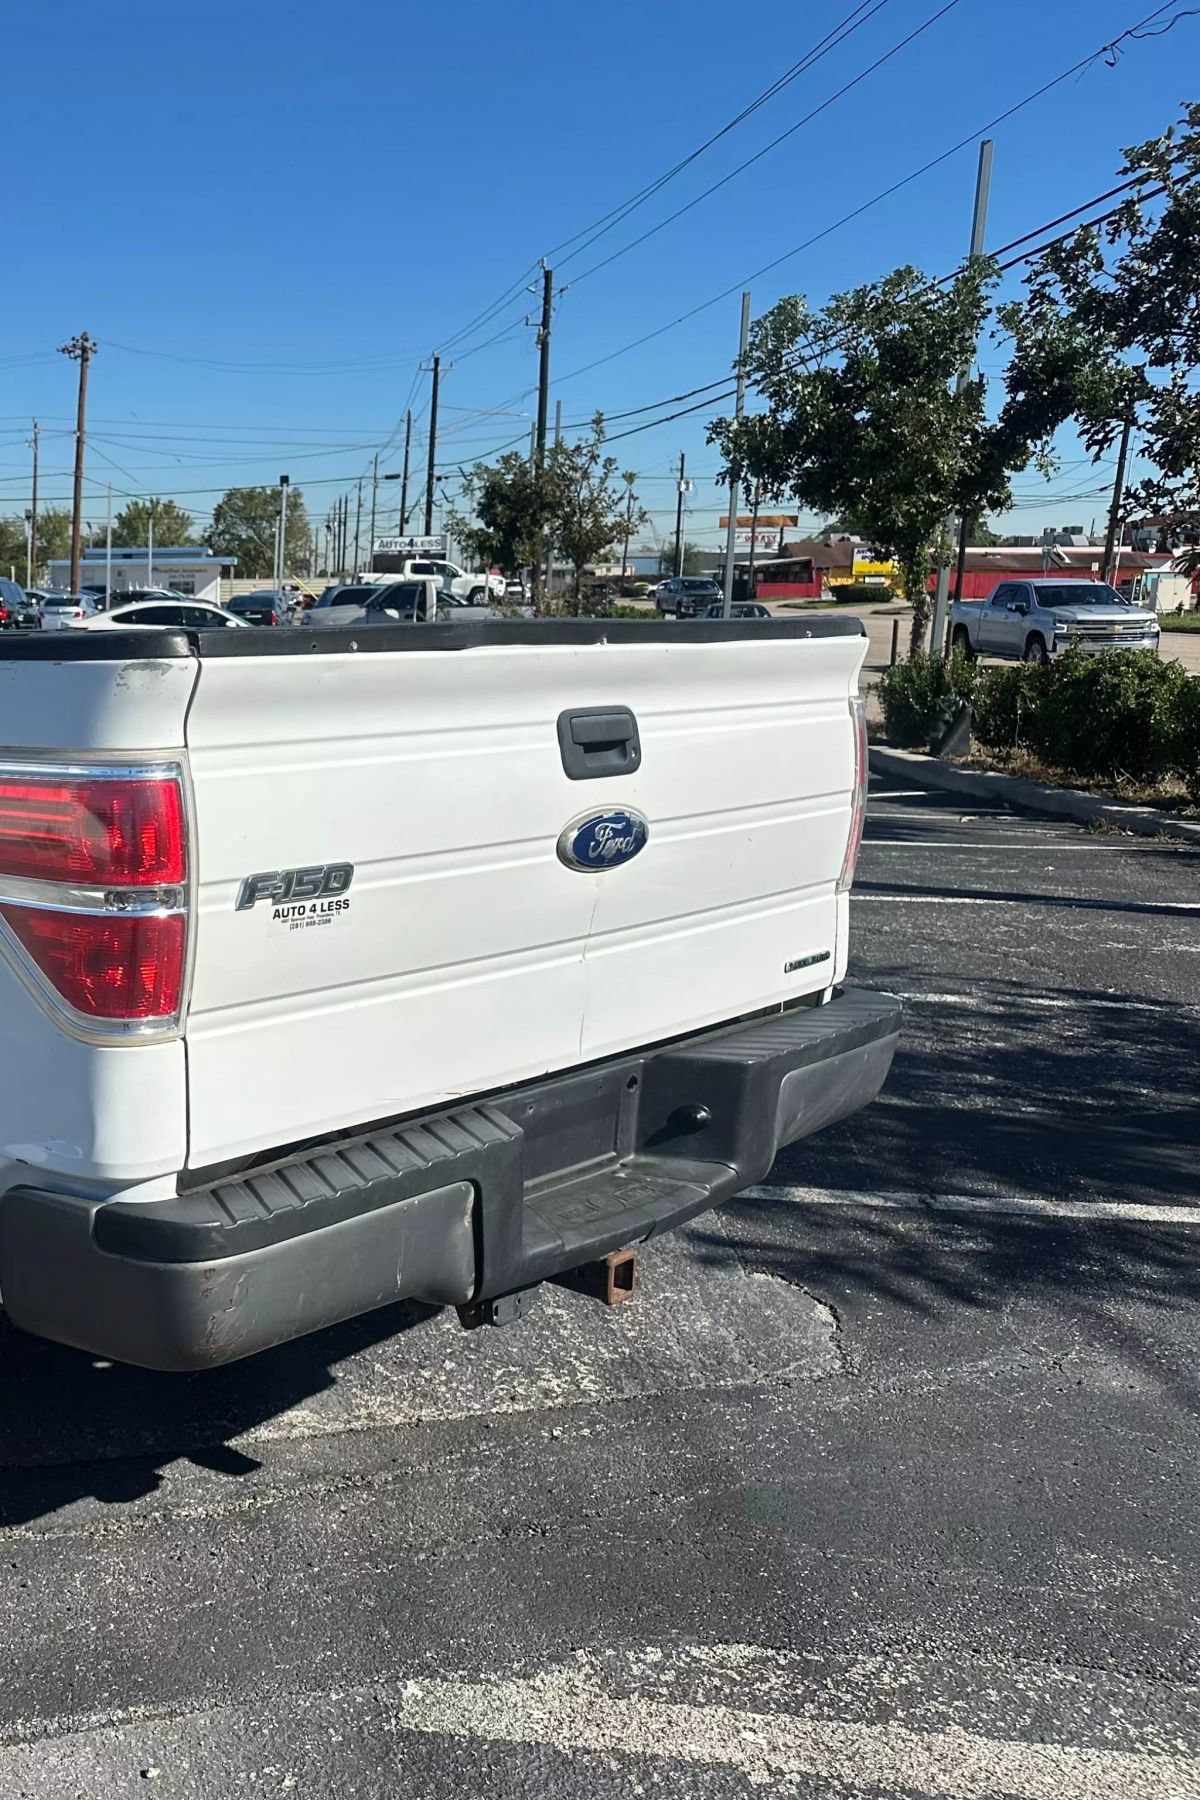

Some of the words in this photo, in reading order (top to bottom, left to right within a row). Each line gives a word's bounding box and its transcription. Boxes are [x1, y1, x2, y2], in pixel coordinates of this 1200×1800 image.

[588, 822, 636, 858] Ford
[235, 862, 354, 911] F-150
[272, 905, 306, 920] AUTO
[309, 903, 317, 914] 4
[321, 899, 350, 912] LESS
